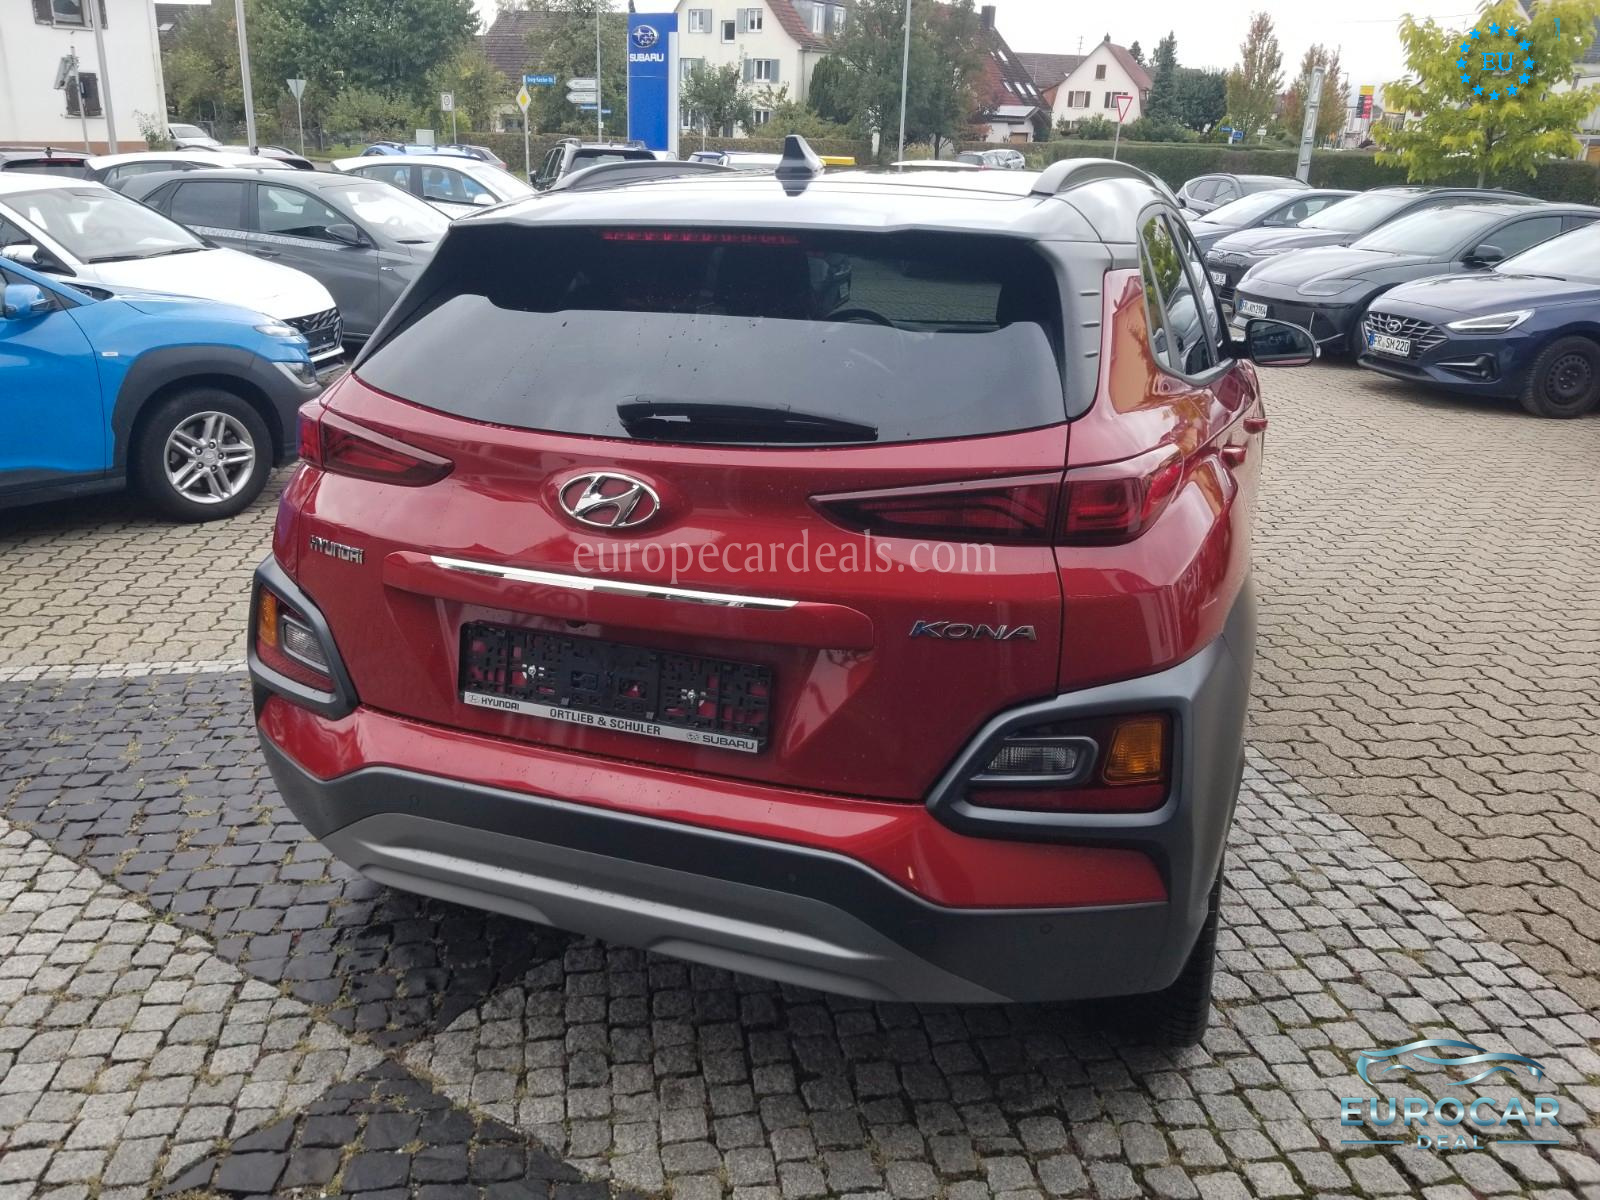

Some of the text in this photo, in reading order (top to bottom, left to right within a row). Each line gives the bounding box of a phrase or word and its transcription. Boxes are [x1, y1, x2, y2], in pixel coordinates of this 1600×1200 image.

[629, 53, 664, 62] SUBARU
[310, 534, 363, 565] HYUNDAI
[909, 620, 1037, 641] KONA
[481, 696, 755, 750] HYUNDAI ORTLIEB & SCHULER SUBARU
